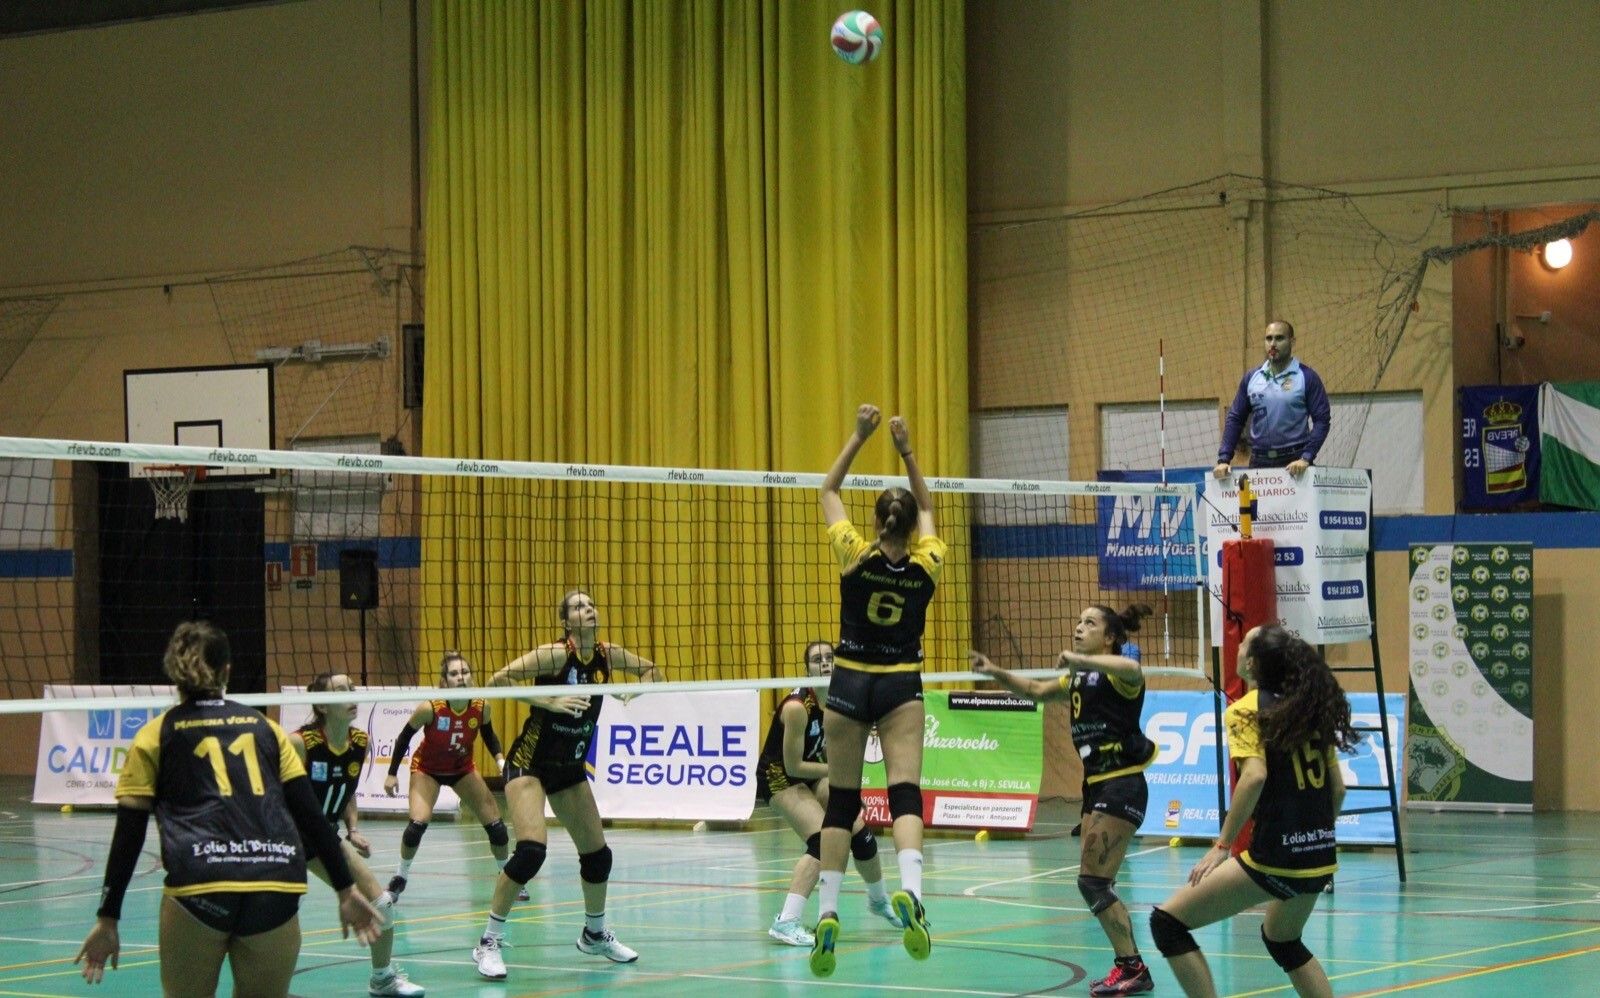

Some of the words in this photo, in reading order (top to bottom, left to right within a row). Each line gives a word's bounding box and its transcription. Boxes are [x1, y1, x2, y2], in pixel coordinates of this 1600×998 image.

[66, 444, 121, 457] rfevb.com
[208, 451, 258, 463] rfevb.com
[337, 457, 383, 468] rfevb.com
[456, 461, 499, 473] rfevb.com
[566, 466, 605, 477] rfevb.com
[667, 470, 704, 481] rfevb.com
[763, 473, 797, 484] rfevb.com
[851, 477, 884, 487] rfevb.com
[934, 479, 965, 489] rfevb.com
[1012, 481, 1040, 491] rfevb.com
[1162, 540, 1197, 555] VOLE
[867, 591, 906, 626] 6
[951, 696, 1034, 707] www.elpanzerocho.com
[1071, 691, 1082, 719] 9
[450, 732, 464, 749] 5
[609, 725, 747, 757] REALE
[48, 744, 128, 774] CALID
[193, 732, 266, 797] 11
[1290, 732, 1326, 790] 15
[607, 763, 747, 787] SEGUROS
[998, 779, 1031, 790] SEVILLA
[863, 795, 885, 806] 100%
[944, 803, 983, 813] Especialistas
[991, 804, 1023, 814] panzerotti
[1182, 808, 1204, 820] REAL
[860, 807, 894, 823] ITALI
[942, 812, 961, 820] Pizzas
[965, 812, 985, 821] Pastas
[989, 813, 1017, 822] Antipasti
